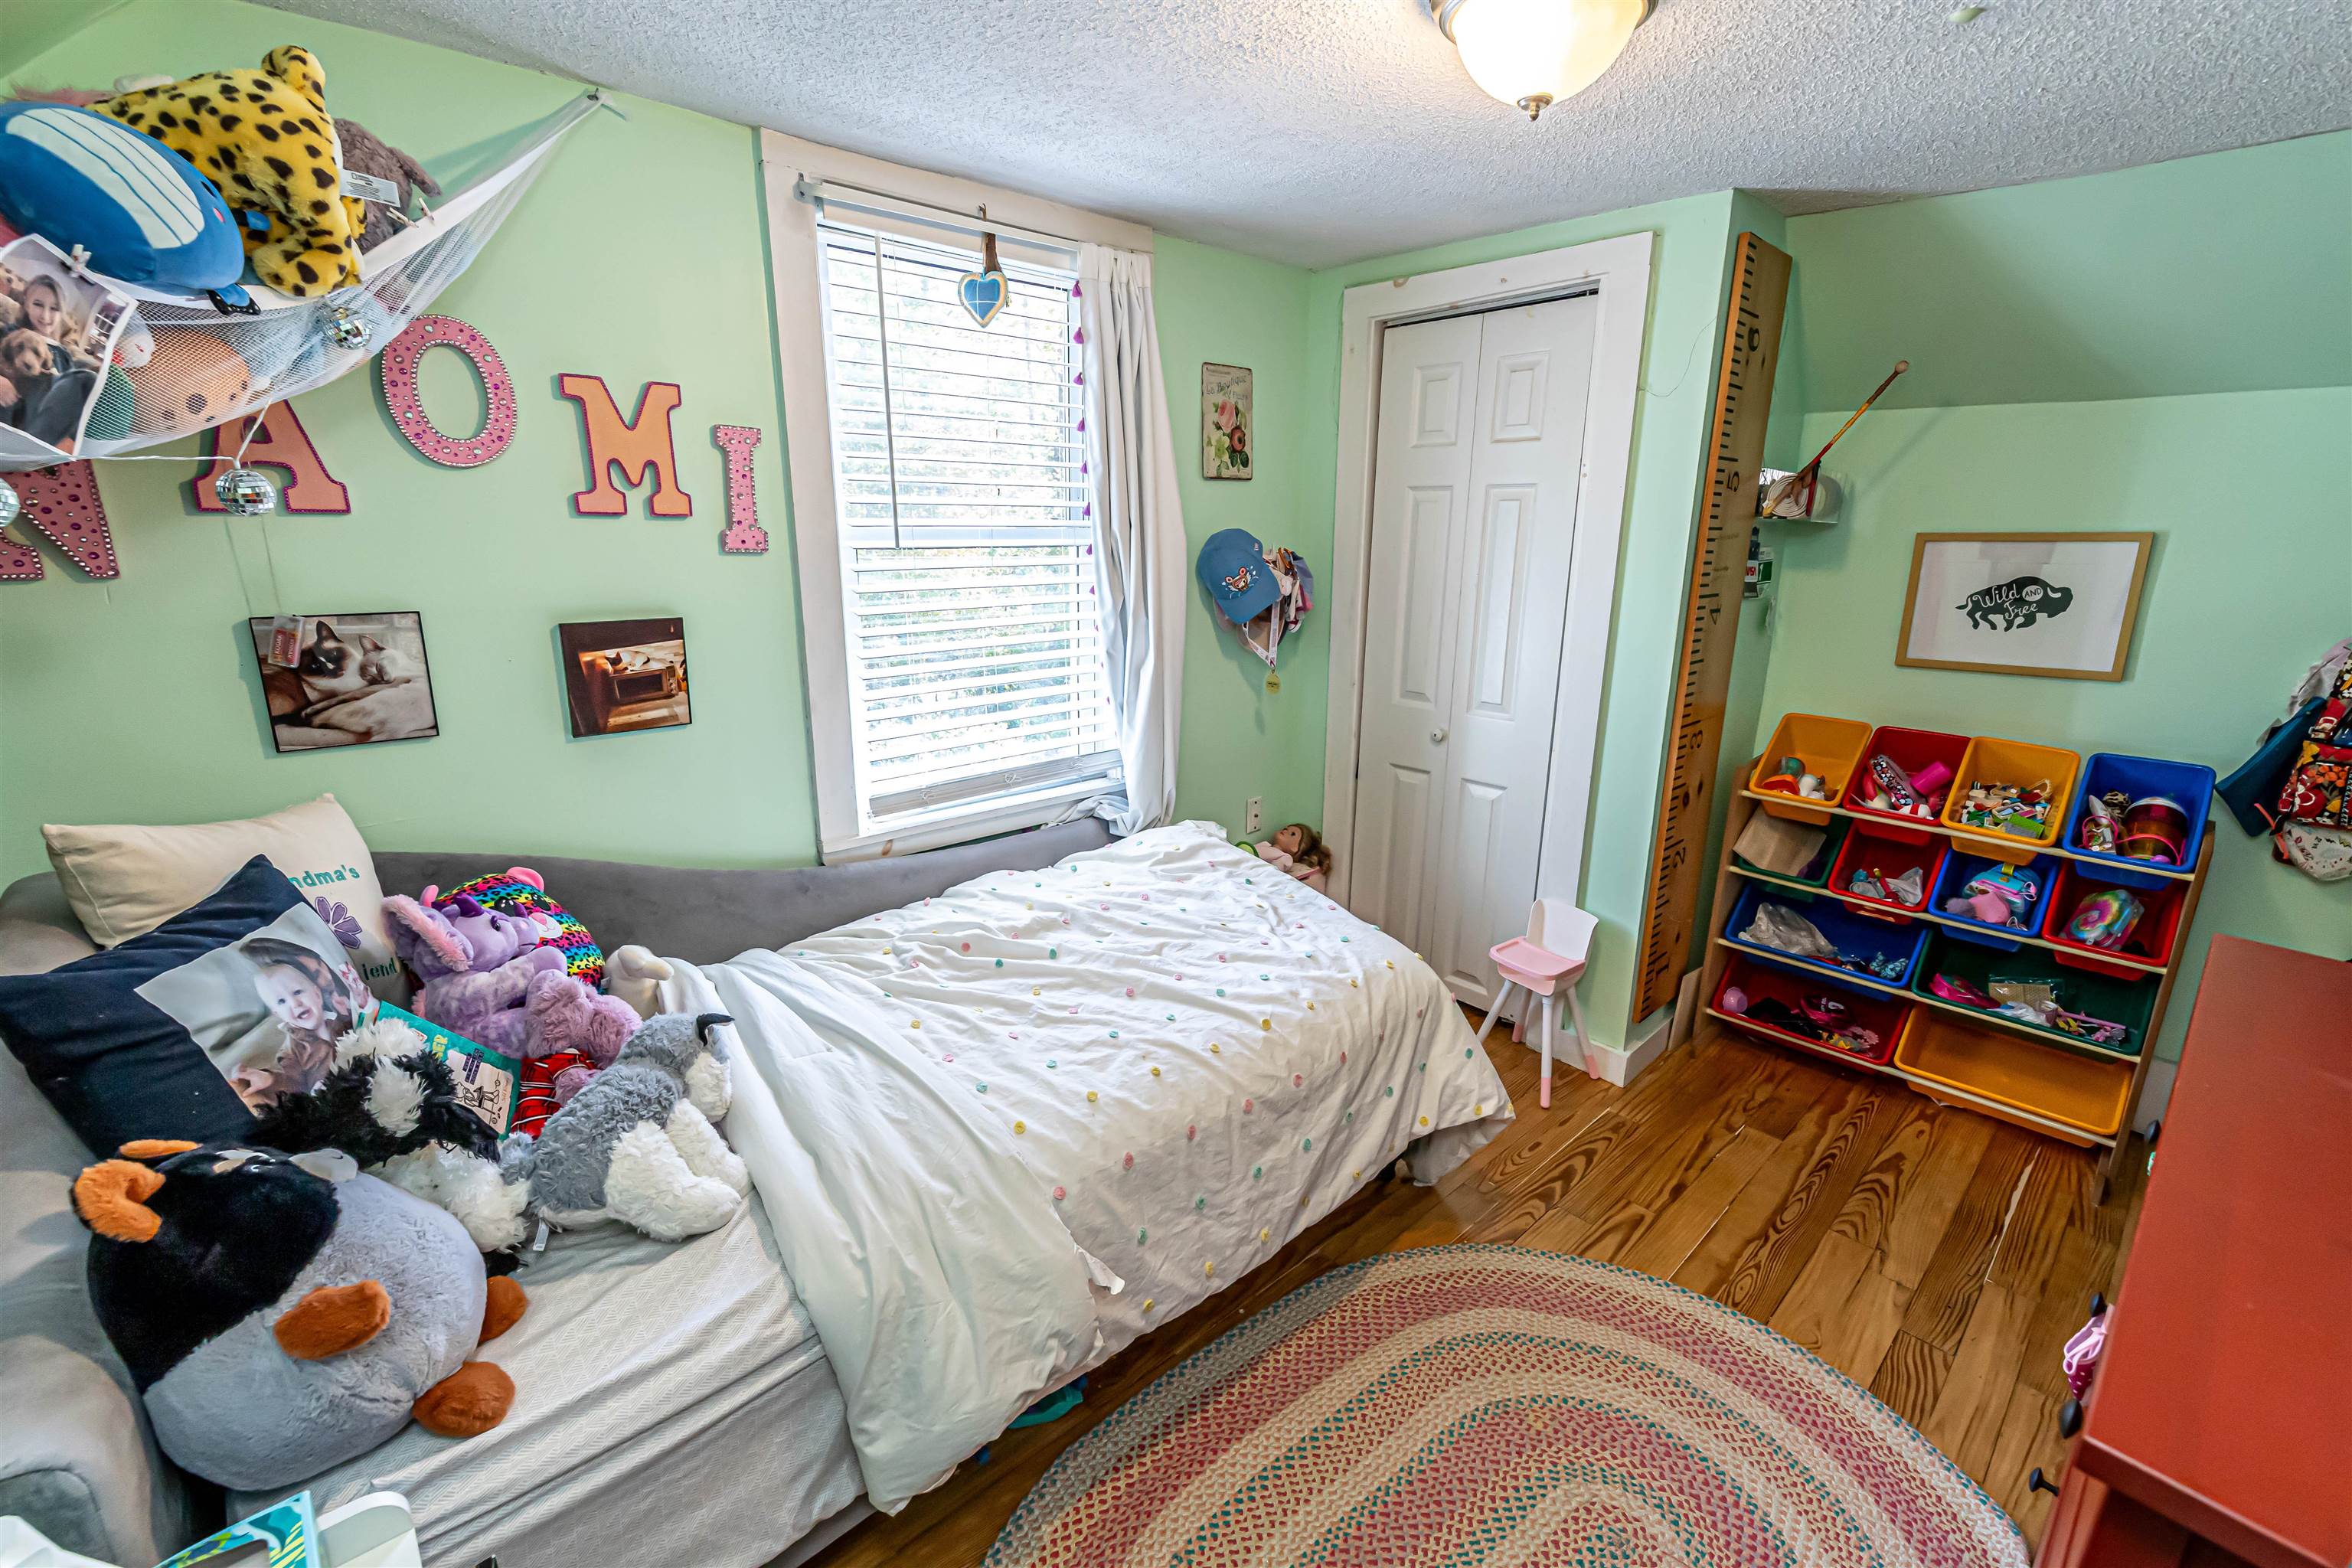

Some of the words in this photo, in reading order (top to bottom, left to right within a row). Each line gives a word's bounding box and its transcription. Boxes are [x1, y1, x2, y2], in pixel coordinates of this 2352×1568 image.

[1727, 471, 1740, 492] 5
[1972, 583, 2020, 607] Wild
[2024, 587, 2042, 599] AND
[1710, 602, 1722, 626] 4
[2004, 599, 2038, 619] Free
[1690, 730, 1704, 749] 3
[1673, 847, 1686, 868] 2
[1655, 957, 1671, 981] 1
